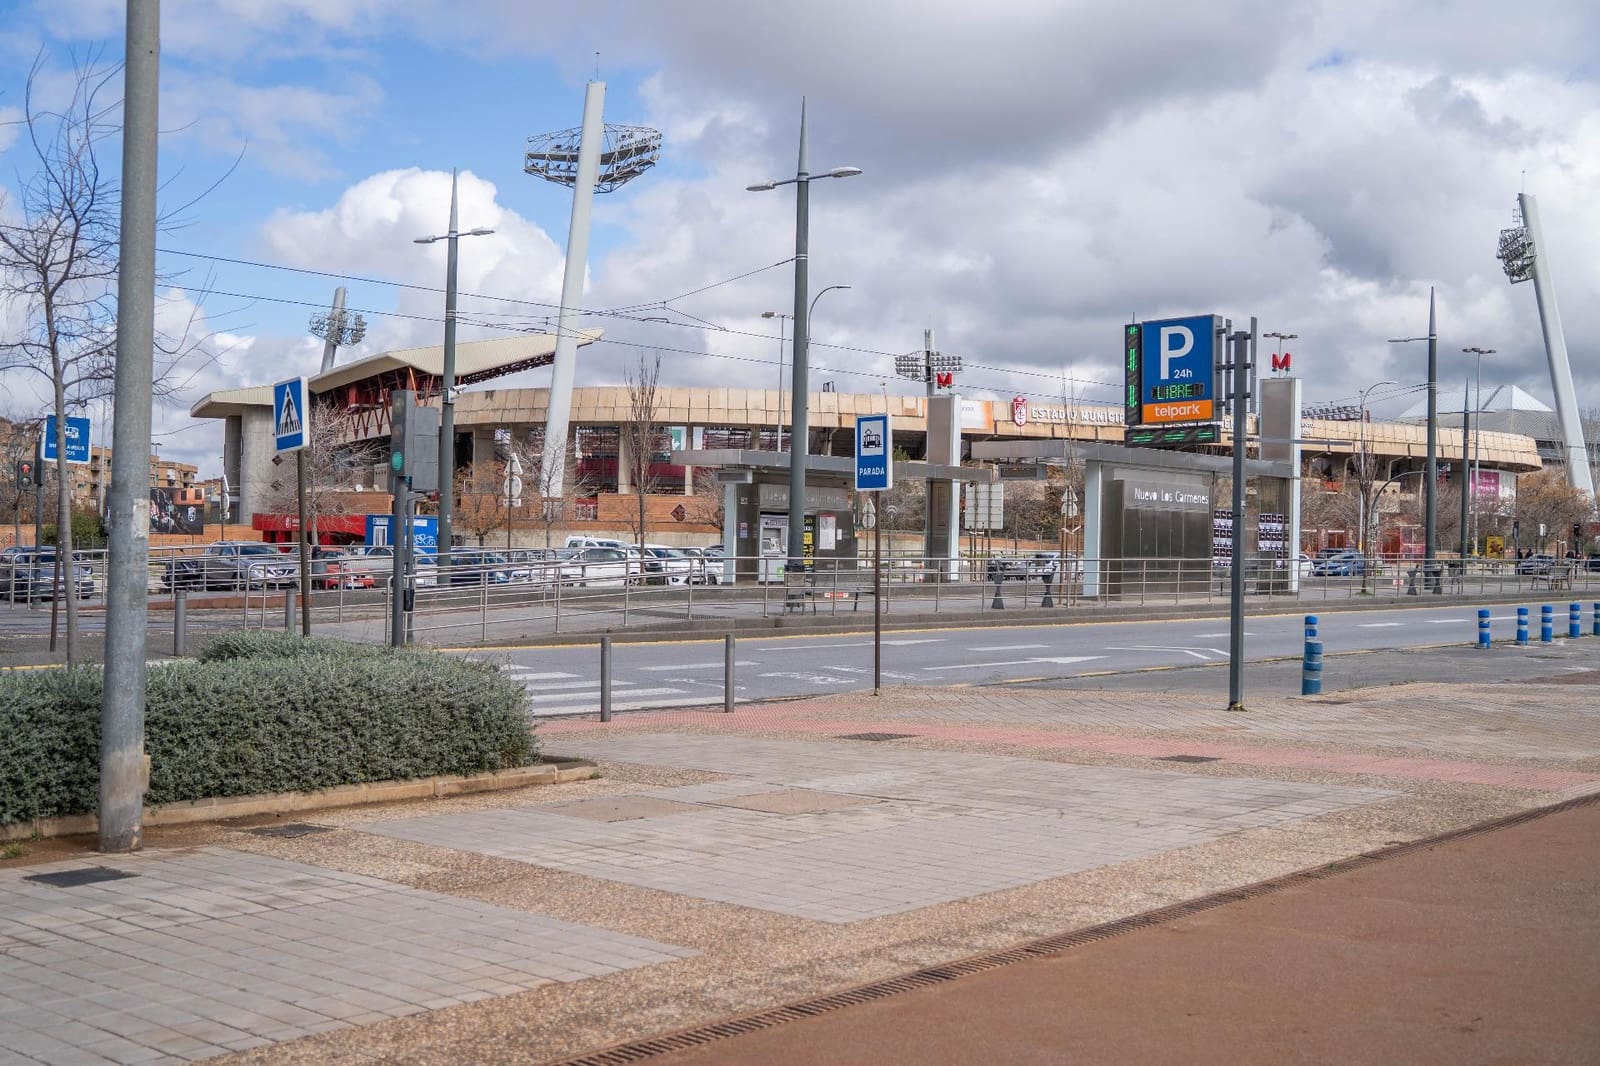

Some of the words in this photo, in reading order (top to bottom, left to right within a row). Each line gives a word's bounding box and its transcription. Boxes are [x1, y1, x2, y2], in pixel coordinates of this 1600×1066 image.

[1160, 325, 1194, 380] P
[1174, 368, 1193, 379] 24h
[1154, 403, 1200, 418] telpark
[859, 466, 885, 477] PARADA
[1134, 487, 1158, 501] Nuevo
[1161, 489, 1174, 502] Los
[1175, 490, 1209, 505] Carmenes
